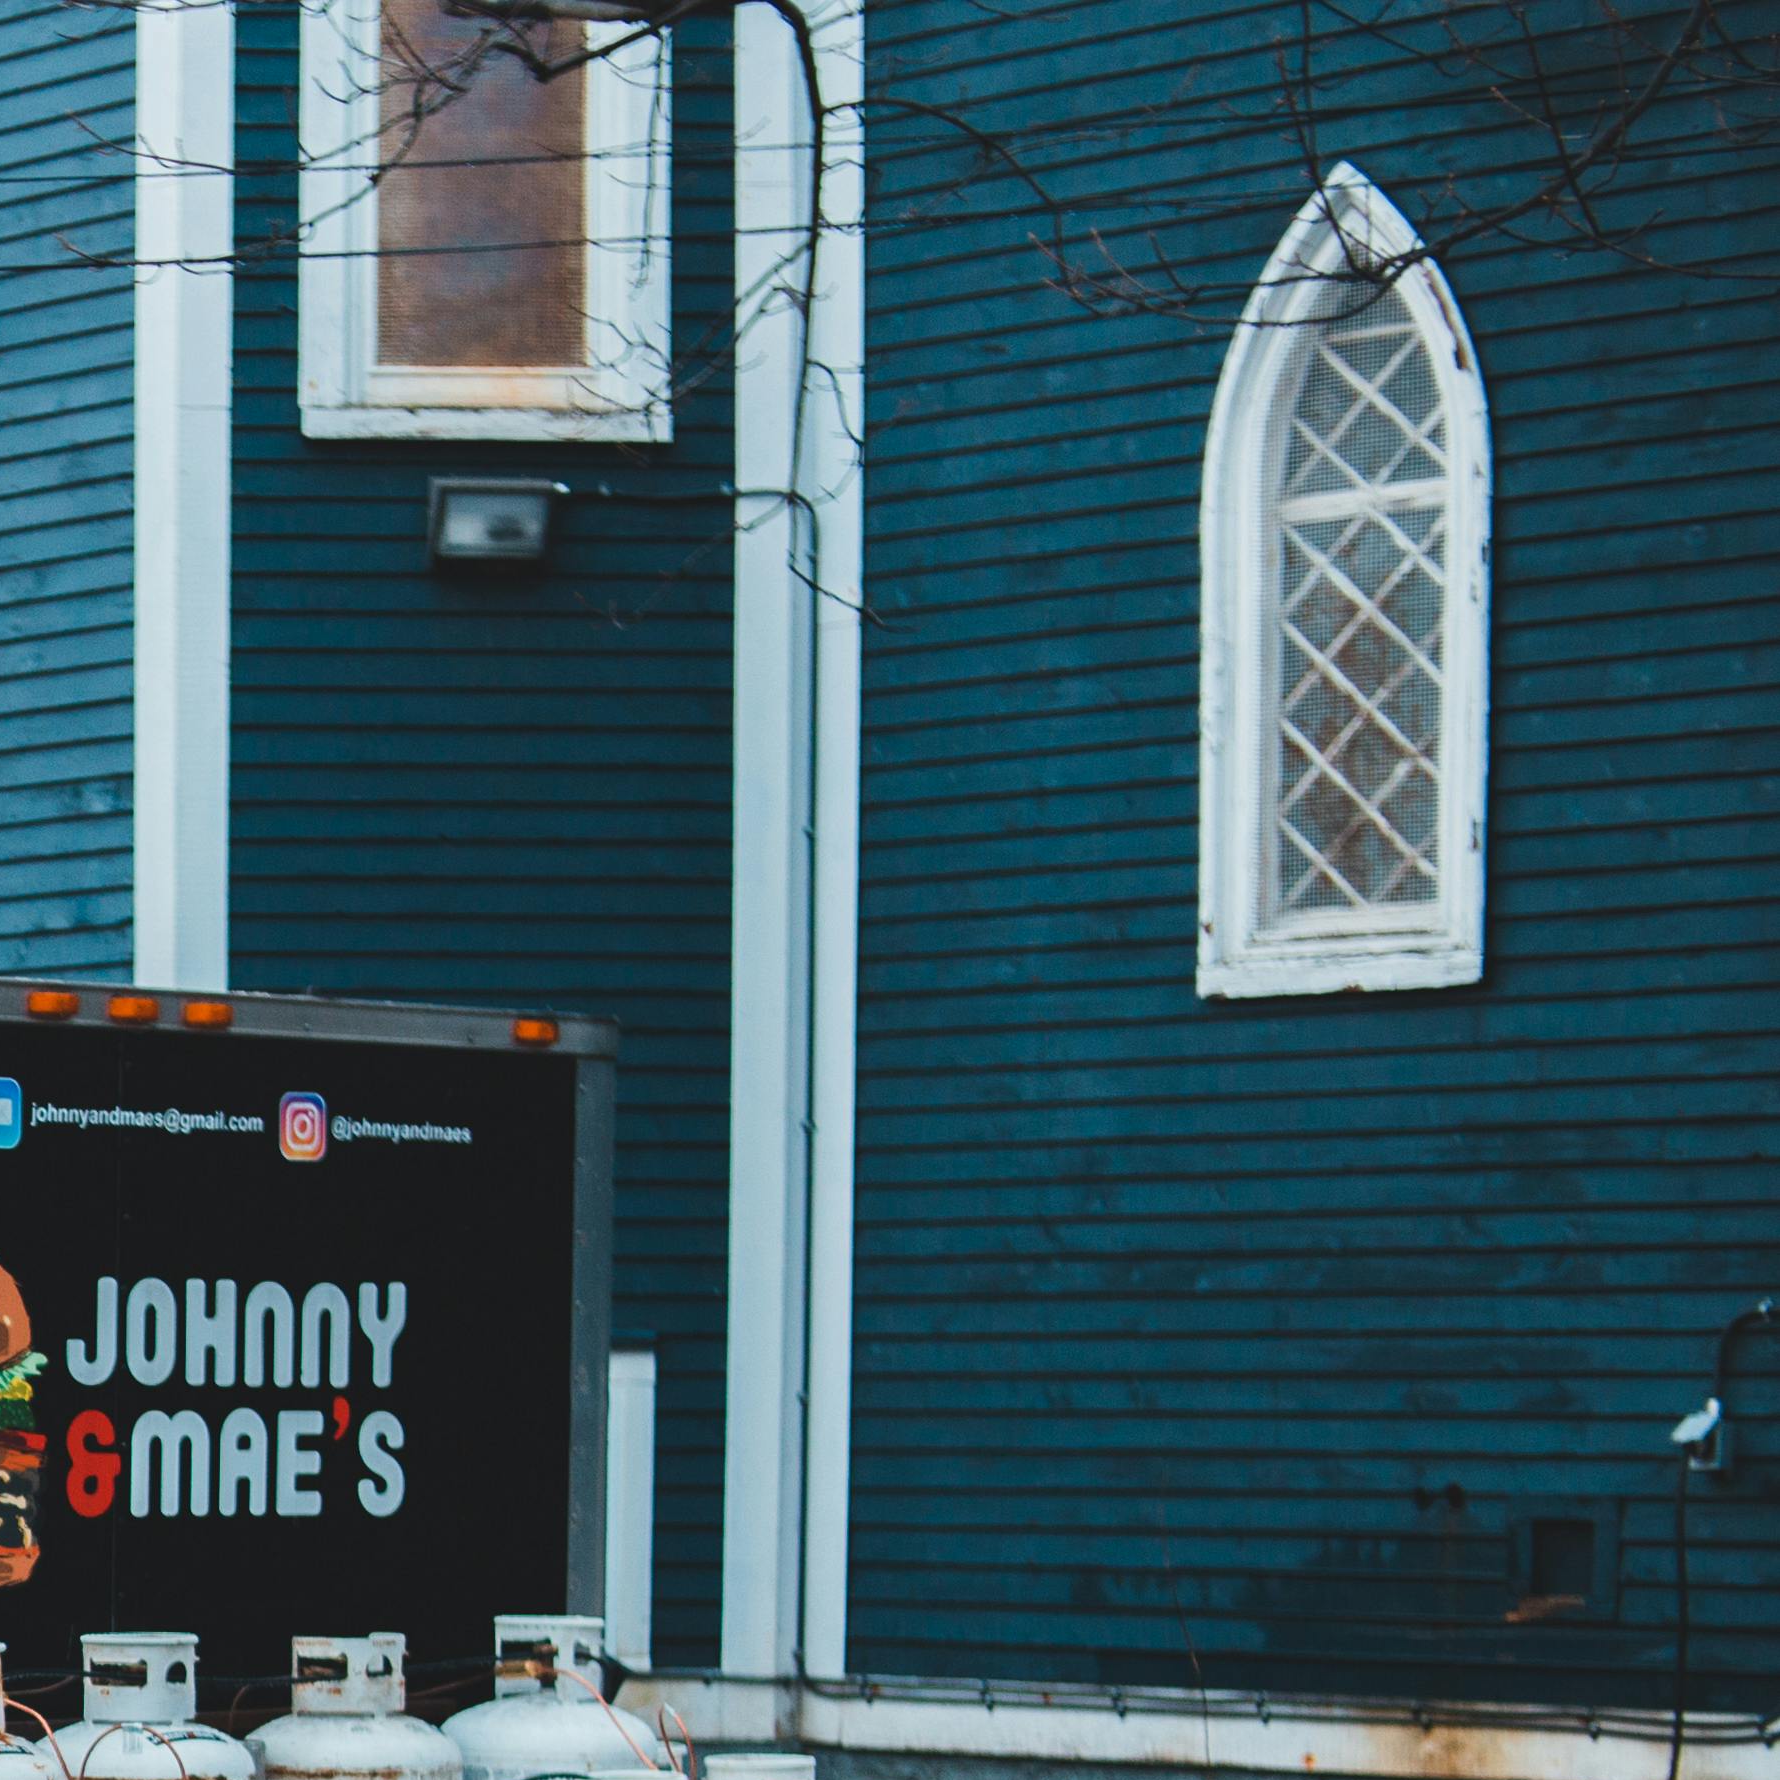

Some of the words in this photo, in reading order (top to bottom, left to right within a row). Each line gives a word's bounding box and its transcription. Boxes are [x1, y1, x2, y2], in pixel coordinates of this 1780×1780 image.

[30, 1102, 264, 1134] johnnyandmaes@gmail.com
[331, 1115, 472, 1144] @johnnyandmaes
[66, 1277, 407, 1388] JOHNNY
